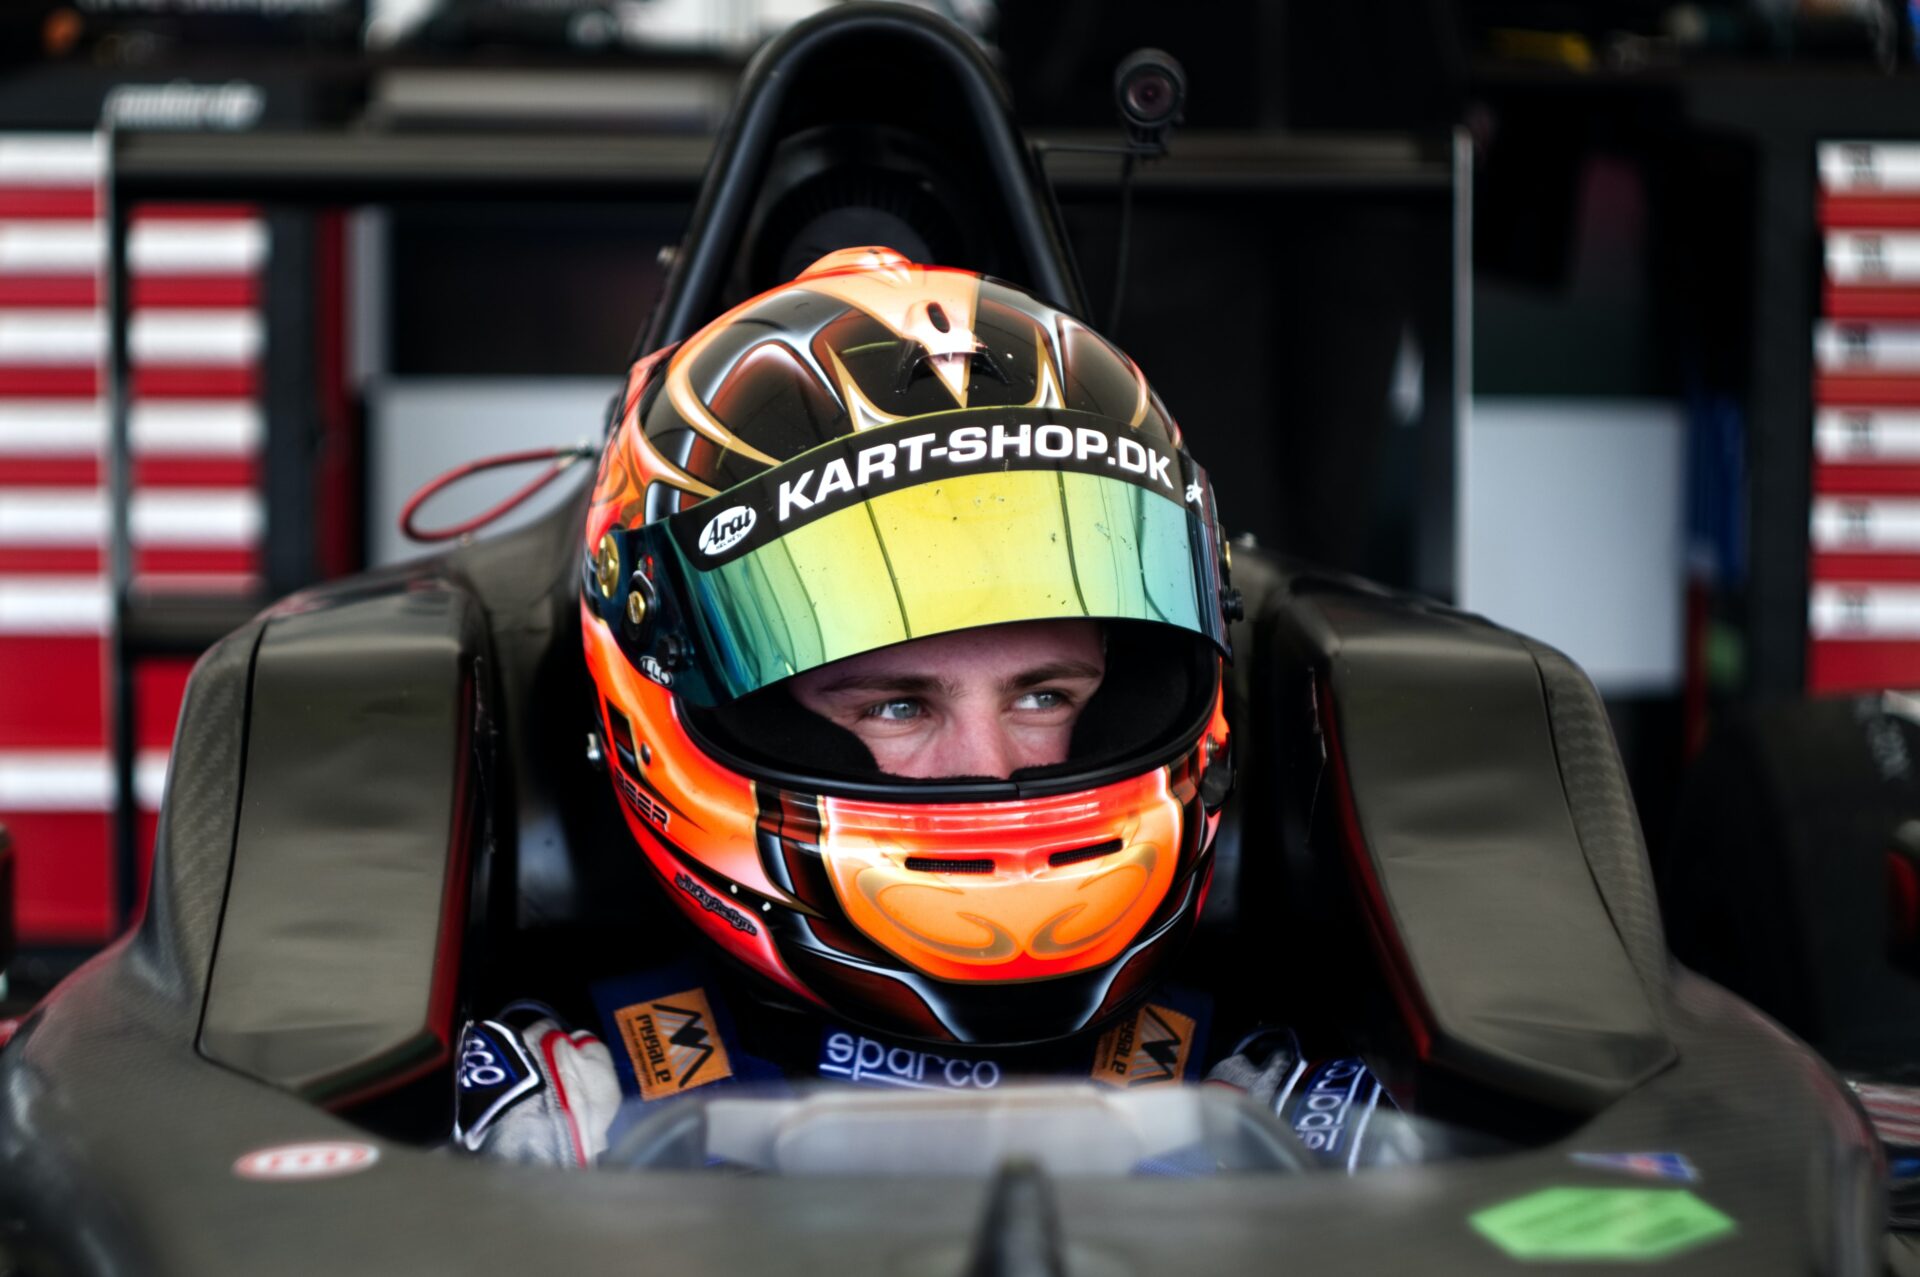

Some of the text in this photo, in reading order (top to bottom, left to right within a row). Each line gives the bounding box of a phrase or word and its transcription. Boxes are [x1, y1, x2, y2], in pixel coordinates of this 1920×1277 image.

[778, 424, 1174, 521] KART-SHOP.DK
[701, 505, 752, 551] Arai
[826, 1033, 999, 1089] sparco
